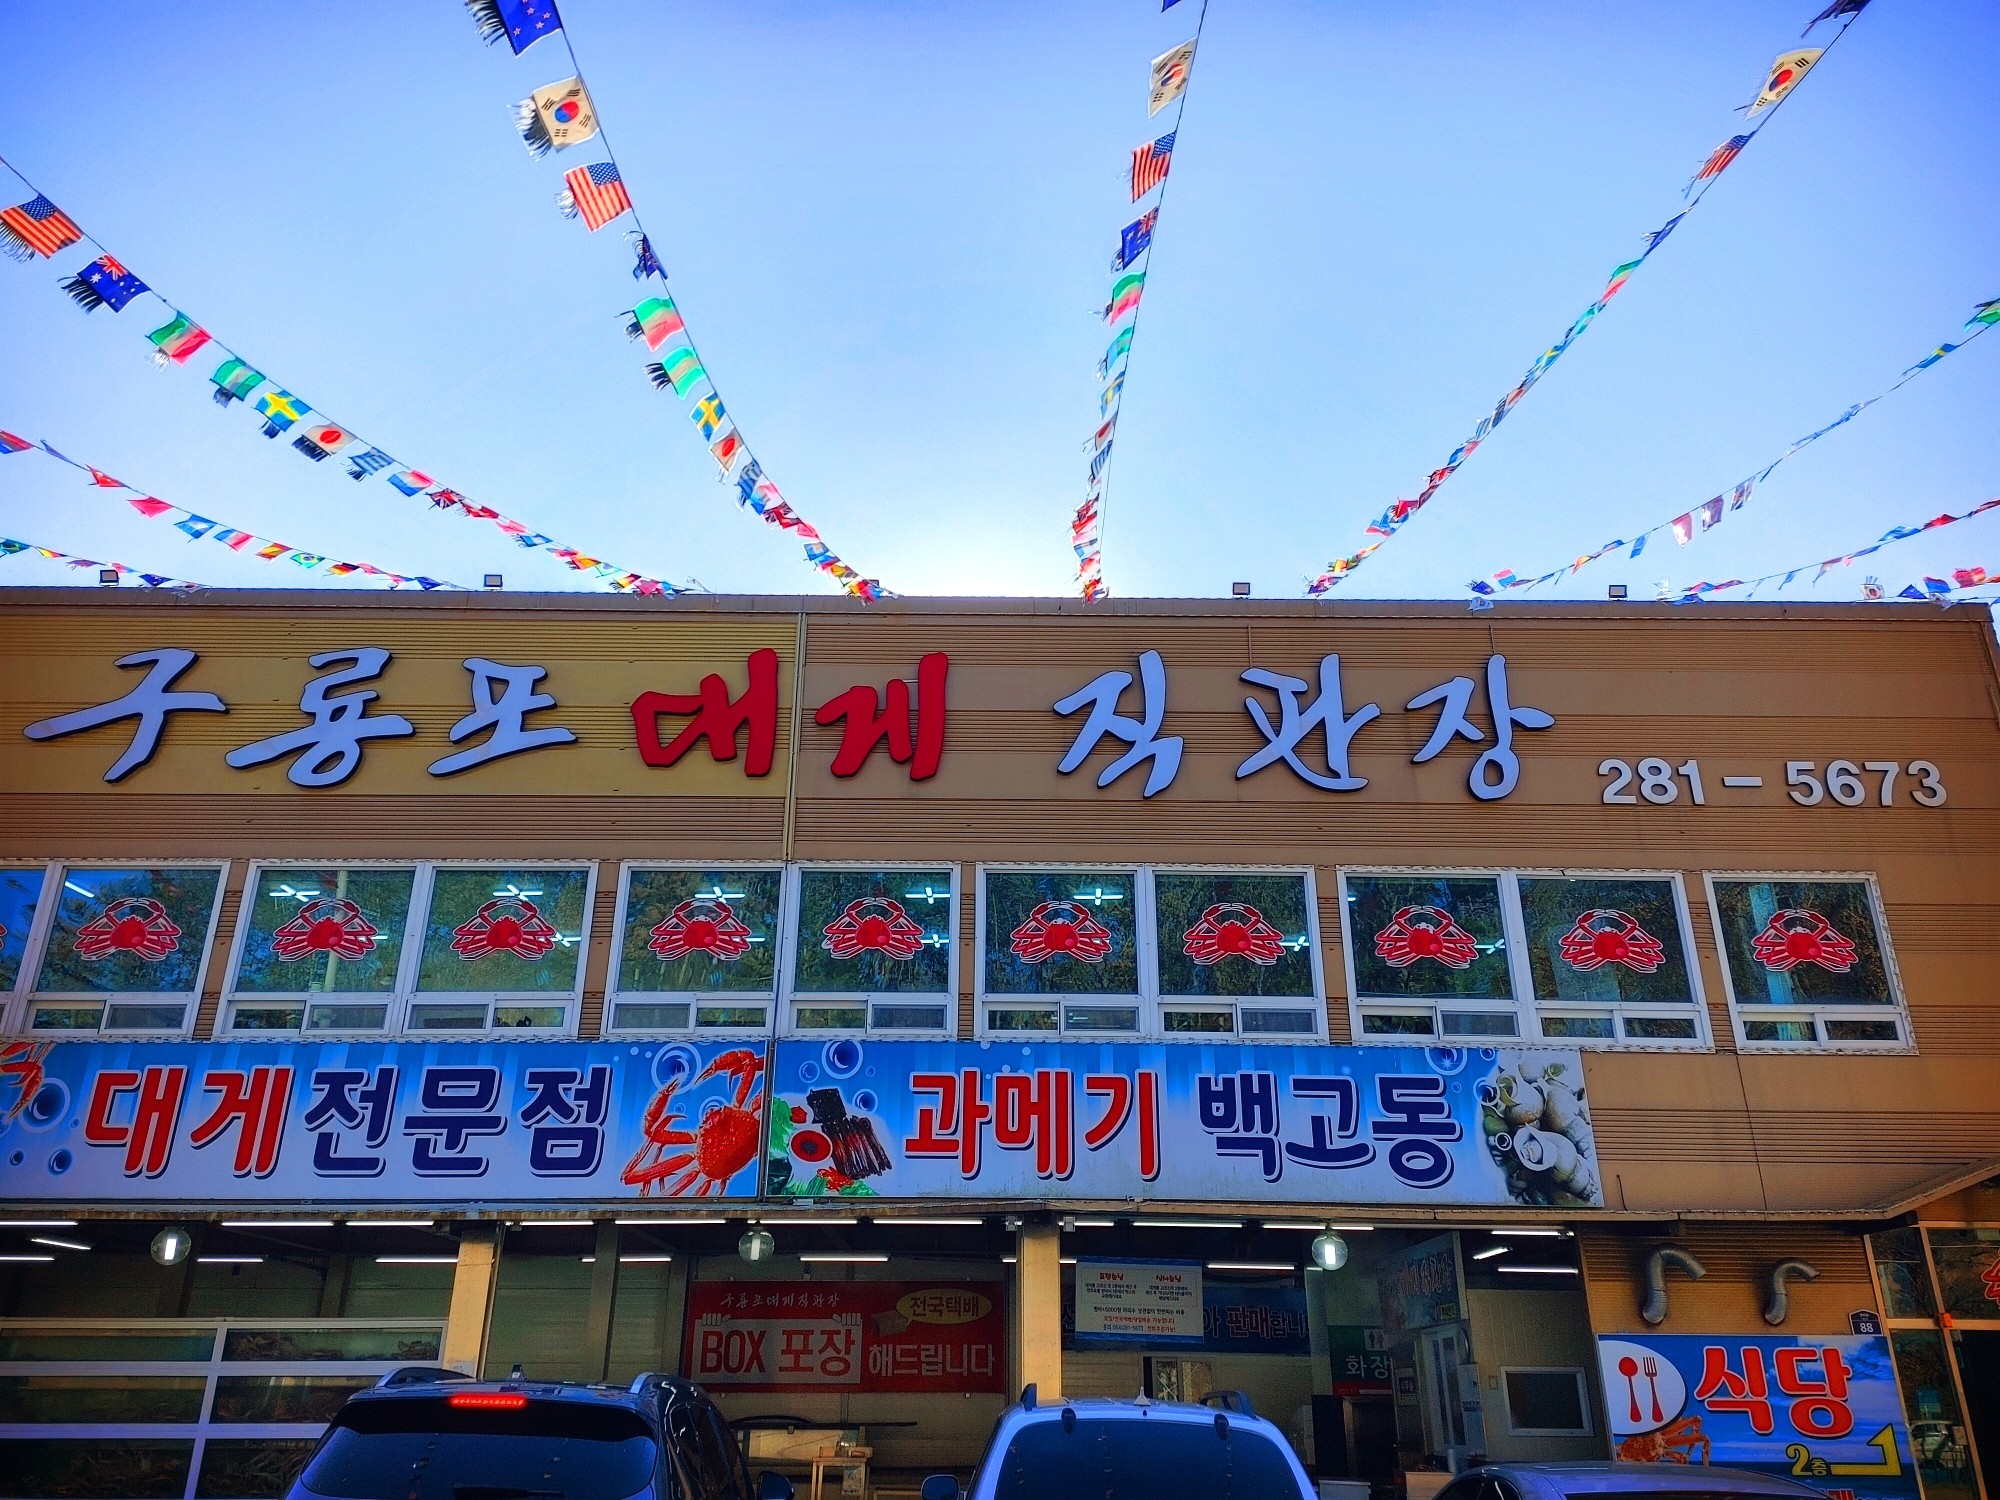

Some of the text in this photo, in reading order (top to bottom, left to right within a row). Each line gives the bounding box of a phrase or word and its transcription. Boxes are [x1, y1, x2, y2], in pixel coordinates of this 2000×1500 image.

[22, 647, 1556, 801] 구룡포 대게 직판장
[1598, 757, 1706, 806] 281
[1786, 759, 1948, 808] 5673
[83, 1064, 613, 1179] 대게전문점
[903, 1067, 1465, 1189] 과메기 백고동
[909, 1295, 981, 1318] 전국택배
[1226, 1305, 1310, 1339] 판매합니
[1859, 1322, 1874, 1333] 88
[699, 1328, 857, 1377] BOX 포장
[868, 1343, 996, 1378] 해드립니다
[1345, 1355, 1391, 1380] 화장
[1694, 1345, 1855, 1438] 식당
[1785, 1443, 1828, 1477] 2층
